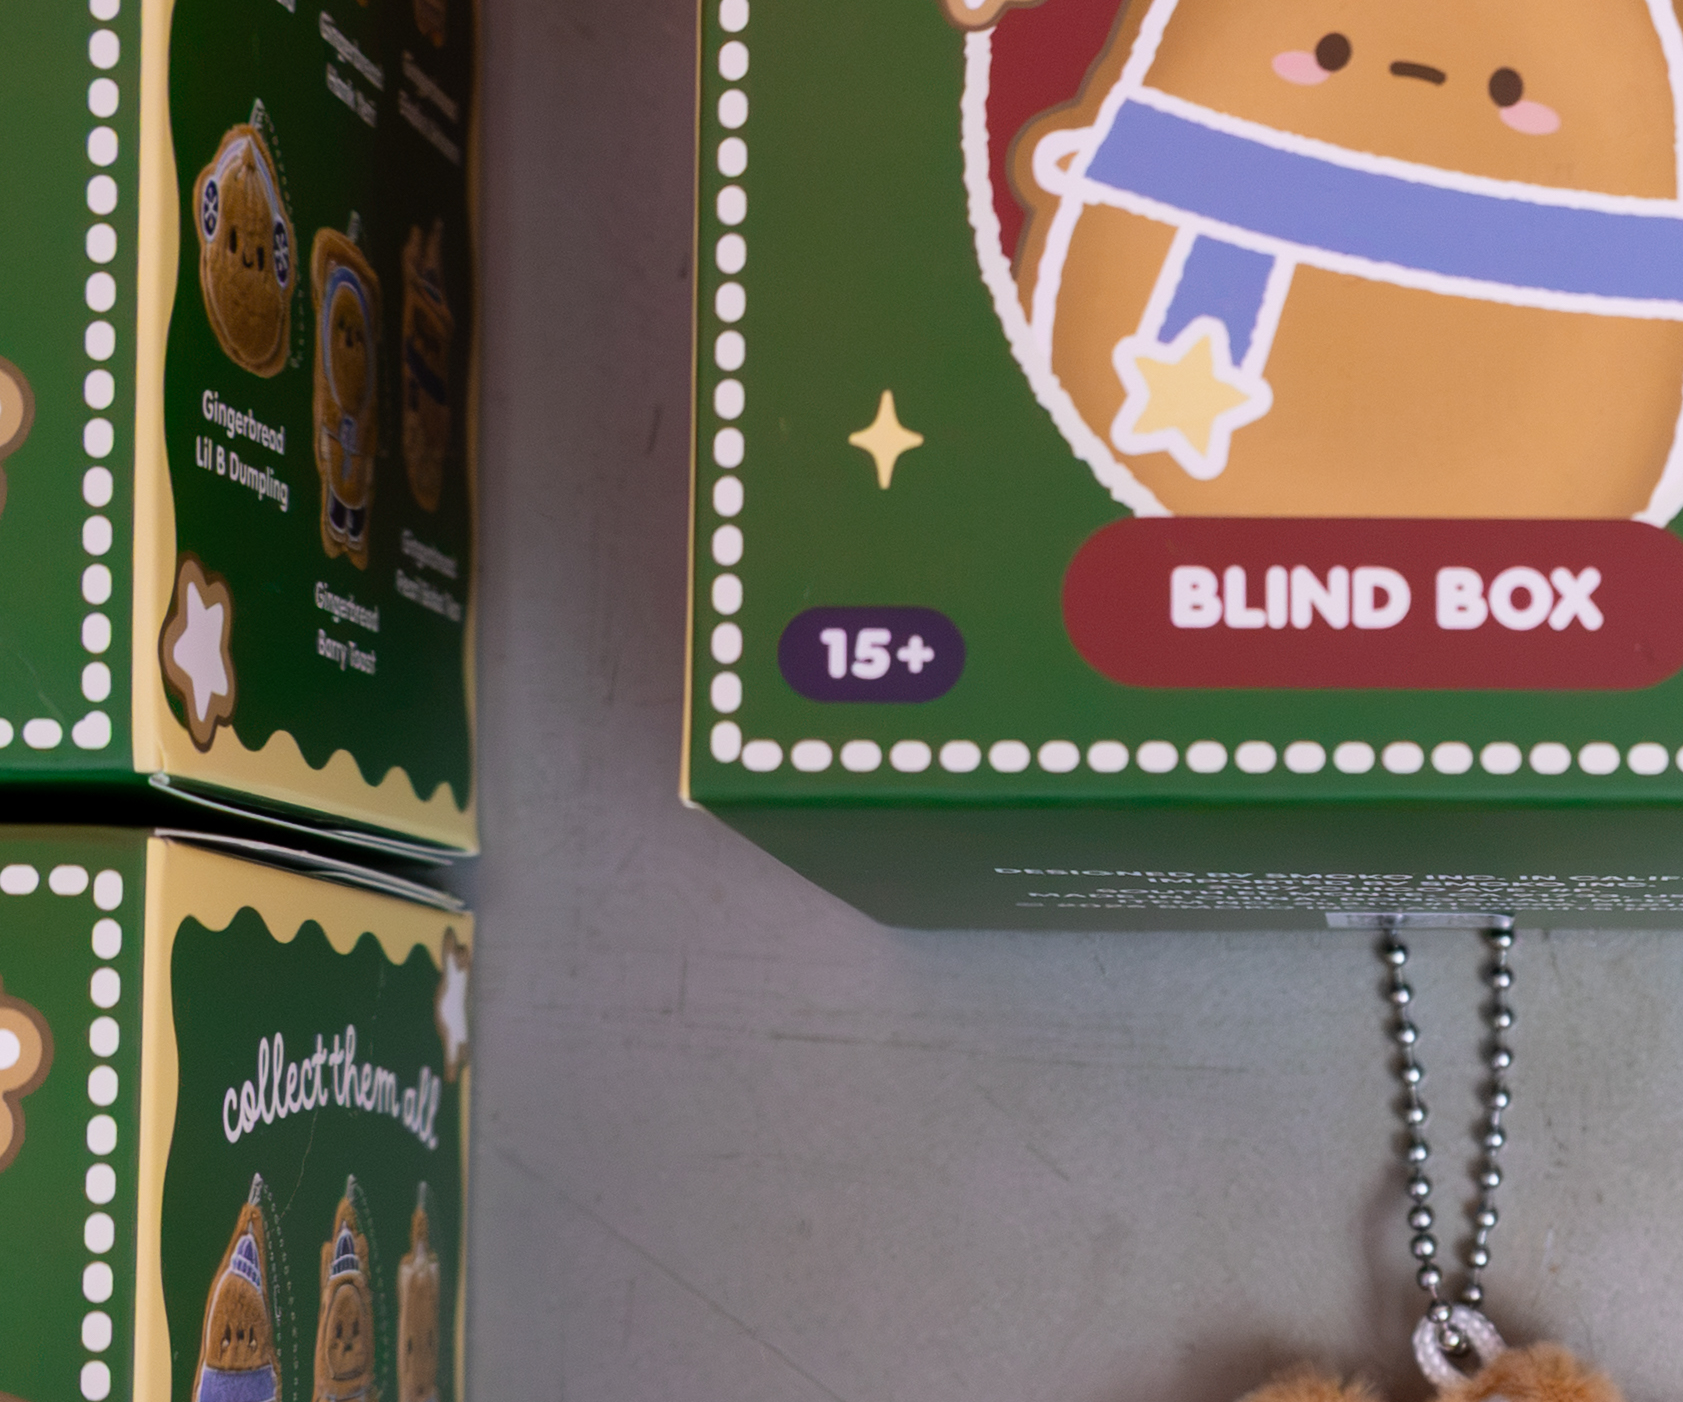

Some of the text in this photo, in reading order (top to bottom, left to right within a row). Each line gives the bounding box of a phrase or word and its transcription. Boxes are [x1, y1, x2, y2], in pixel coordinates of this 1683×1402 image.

[202, 389, 285, 456] Gingerbread
[195, 435, 289, 513] Lil B Dumpling
[1168, 564, 1604, 632] BLIND BOX
[819, 626, 936, 681] 15+
[993, 867, 1195, 877] DESIGNED
[1265, 872, 1413, 880] SMOKO
[1147, 877, 1349, 886] IMPORTED
[222, 1031, 328, 1144] collect
[327, 1023, 400, 1118] them
